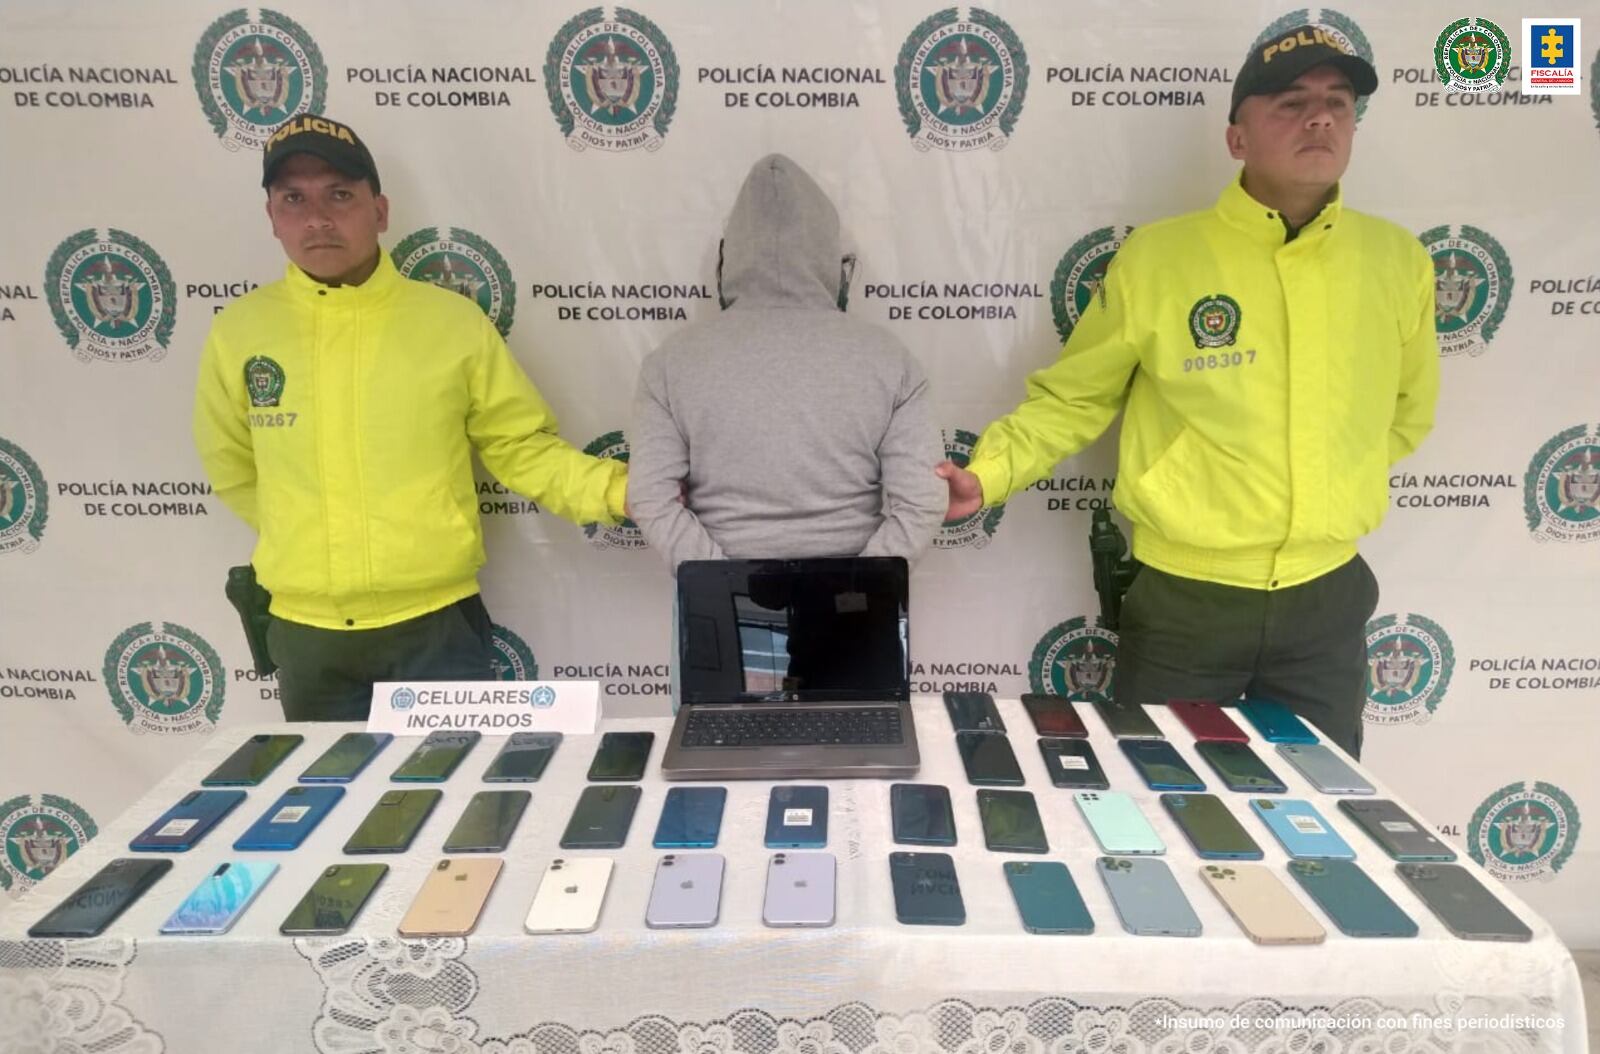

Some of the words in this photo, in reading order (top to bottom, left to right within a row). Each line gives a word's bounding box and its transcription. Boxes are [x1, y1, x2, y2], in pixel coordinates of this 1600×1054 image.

[250, 25, 266, 34] DE
[276, 30, 312, 88] COLOMBIA
[604, 24, 619, 32] DE
[630, 30, 664, 88] COLOMBIA
[957, 24, 973, 33] DE
[982, 29, 1013, 88] COLOMBIA
[0, 63, 64, 83] OLICÍA
[68, 67, 178, 84] NACIONAL
[346, 64, 427, 83] POLICÍA
[431, 67, 537, 83] NACIONAL
[698, 64, 776, 83] POLICÍA
[782, 67, 886, 83] NACIONAL
[1046, 63, 1125, 83] POLICÍA
[1130, 67, 1233, 83] NACIONAL
[1392, 68, 1436, 83] POLI
[14, 92, 40, 107] DE
[45, 92, 154, 108] COLOMBIA
[375, 91, 401, 107] DE
[407, 91, 511, 107] COLOMBIA
[725, 92, 749, 107] DE
[755, 92, 860, 107] COLOMBIA
[1071, 91, 1096, 106] DE
[1102, 91, 1205, 106] COLOMBIA
[1415, 92, 1439, 107] DE
[1445, 91, 1553, 106] COLOMBIA
[615, 101, 659, 134] NACIONAL
[961, 101, 1007, 135] NACIONAL
[616, 132, 649, 148] PATRIA
[960, 131, 995, 148] PATRIA
[99, 244, 112, 253] DE
[124, 249, 161, 304] COLOMBIA
[439, 242, 454, 251] DE
[464, 249, 501, 303] COLOMBIA
[1448, 240, 1461, 248] DE
[1471, 246, 1497, 298] COLOMBIA
[532, 281, 606, 298] POLICÍA
[612, 285, 712, 298] NACIONAL
[864, 281, 938, 298] POLICÍA
[944, 284, 1043, 298] NACIONAL
[558, 307, 581, 320] DE
[587, 306, 687, 320] COLOMBIA
[889, 306, 912, 320] DE
[918, 306, 1017, 320] COLOMBIA
[1551, 301, 1575, 315] DE
[118, 313, 160, 347] NACIONAL
[1443, 310, 1490, 341] NACIONAL
[120, 344, 153, 359] PATRIA
[1441, 339, 1474, 353] PATRIA
[1183, 349, 1257, 373] 008307
[944, 443, 956, 451] DE
[57, 479, 128, 496] POLICÍA
[132, 482, 212, 496] NACION
[1424, 475, 1517, 487] NACIONAL
[84, 503, 107, 516] DE
[111, 502, 208, 516] COLOMBIA
[479, 501, 539, 514] OMBIA
[1048, 498, 1070, 510] DE
[1396, 495, 1491, 508] COLOMBIA
[0, 511, 32, 538] ACIONAL
[947, 511, 988, 535] NACIONA
[0, 537, 25, 550] ATRIA
[946, 533, 977, 546] PATRIA
[1417, 631, 1440, 676] COLOMBIA
[553, 663, 623, 678] POLICÍA
[628, 665, 669, 677] NACI
[930, 663, 1022, 676] NACIONAL
[1470, 656, 1536, 671] POLICÍA
[1542, 659, 1600, 671] NACIO
[6, 668, 97, 682] NACIONAL
[605, 683, 672, 695] COLOM
[1489, 678, 1511, 689] DE
[0, 685, 76, 700] OLOMBIA
[417, 690, 530, 705] CELULARES
[1391, 686, 1434, 712] NACIONAL
[407, 713, 533, 728] INCAUTADOS
[1389, 710, 1420, 722] PATRIA
